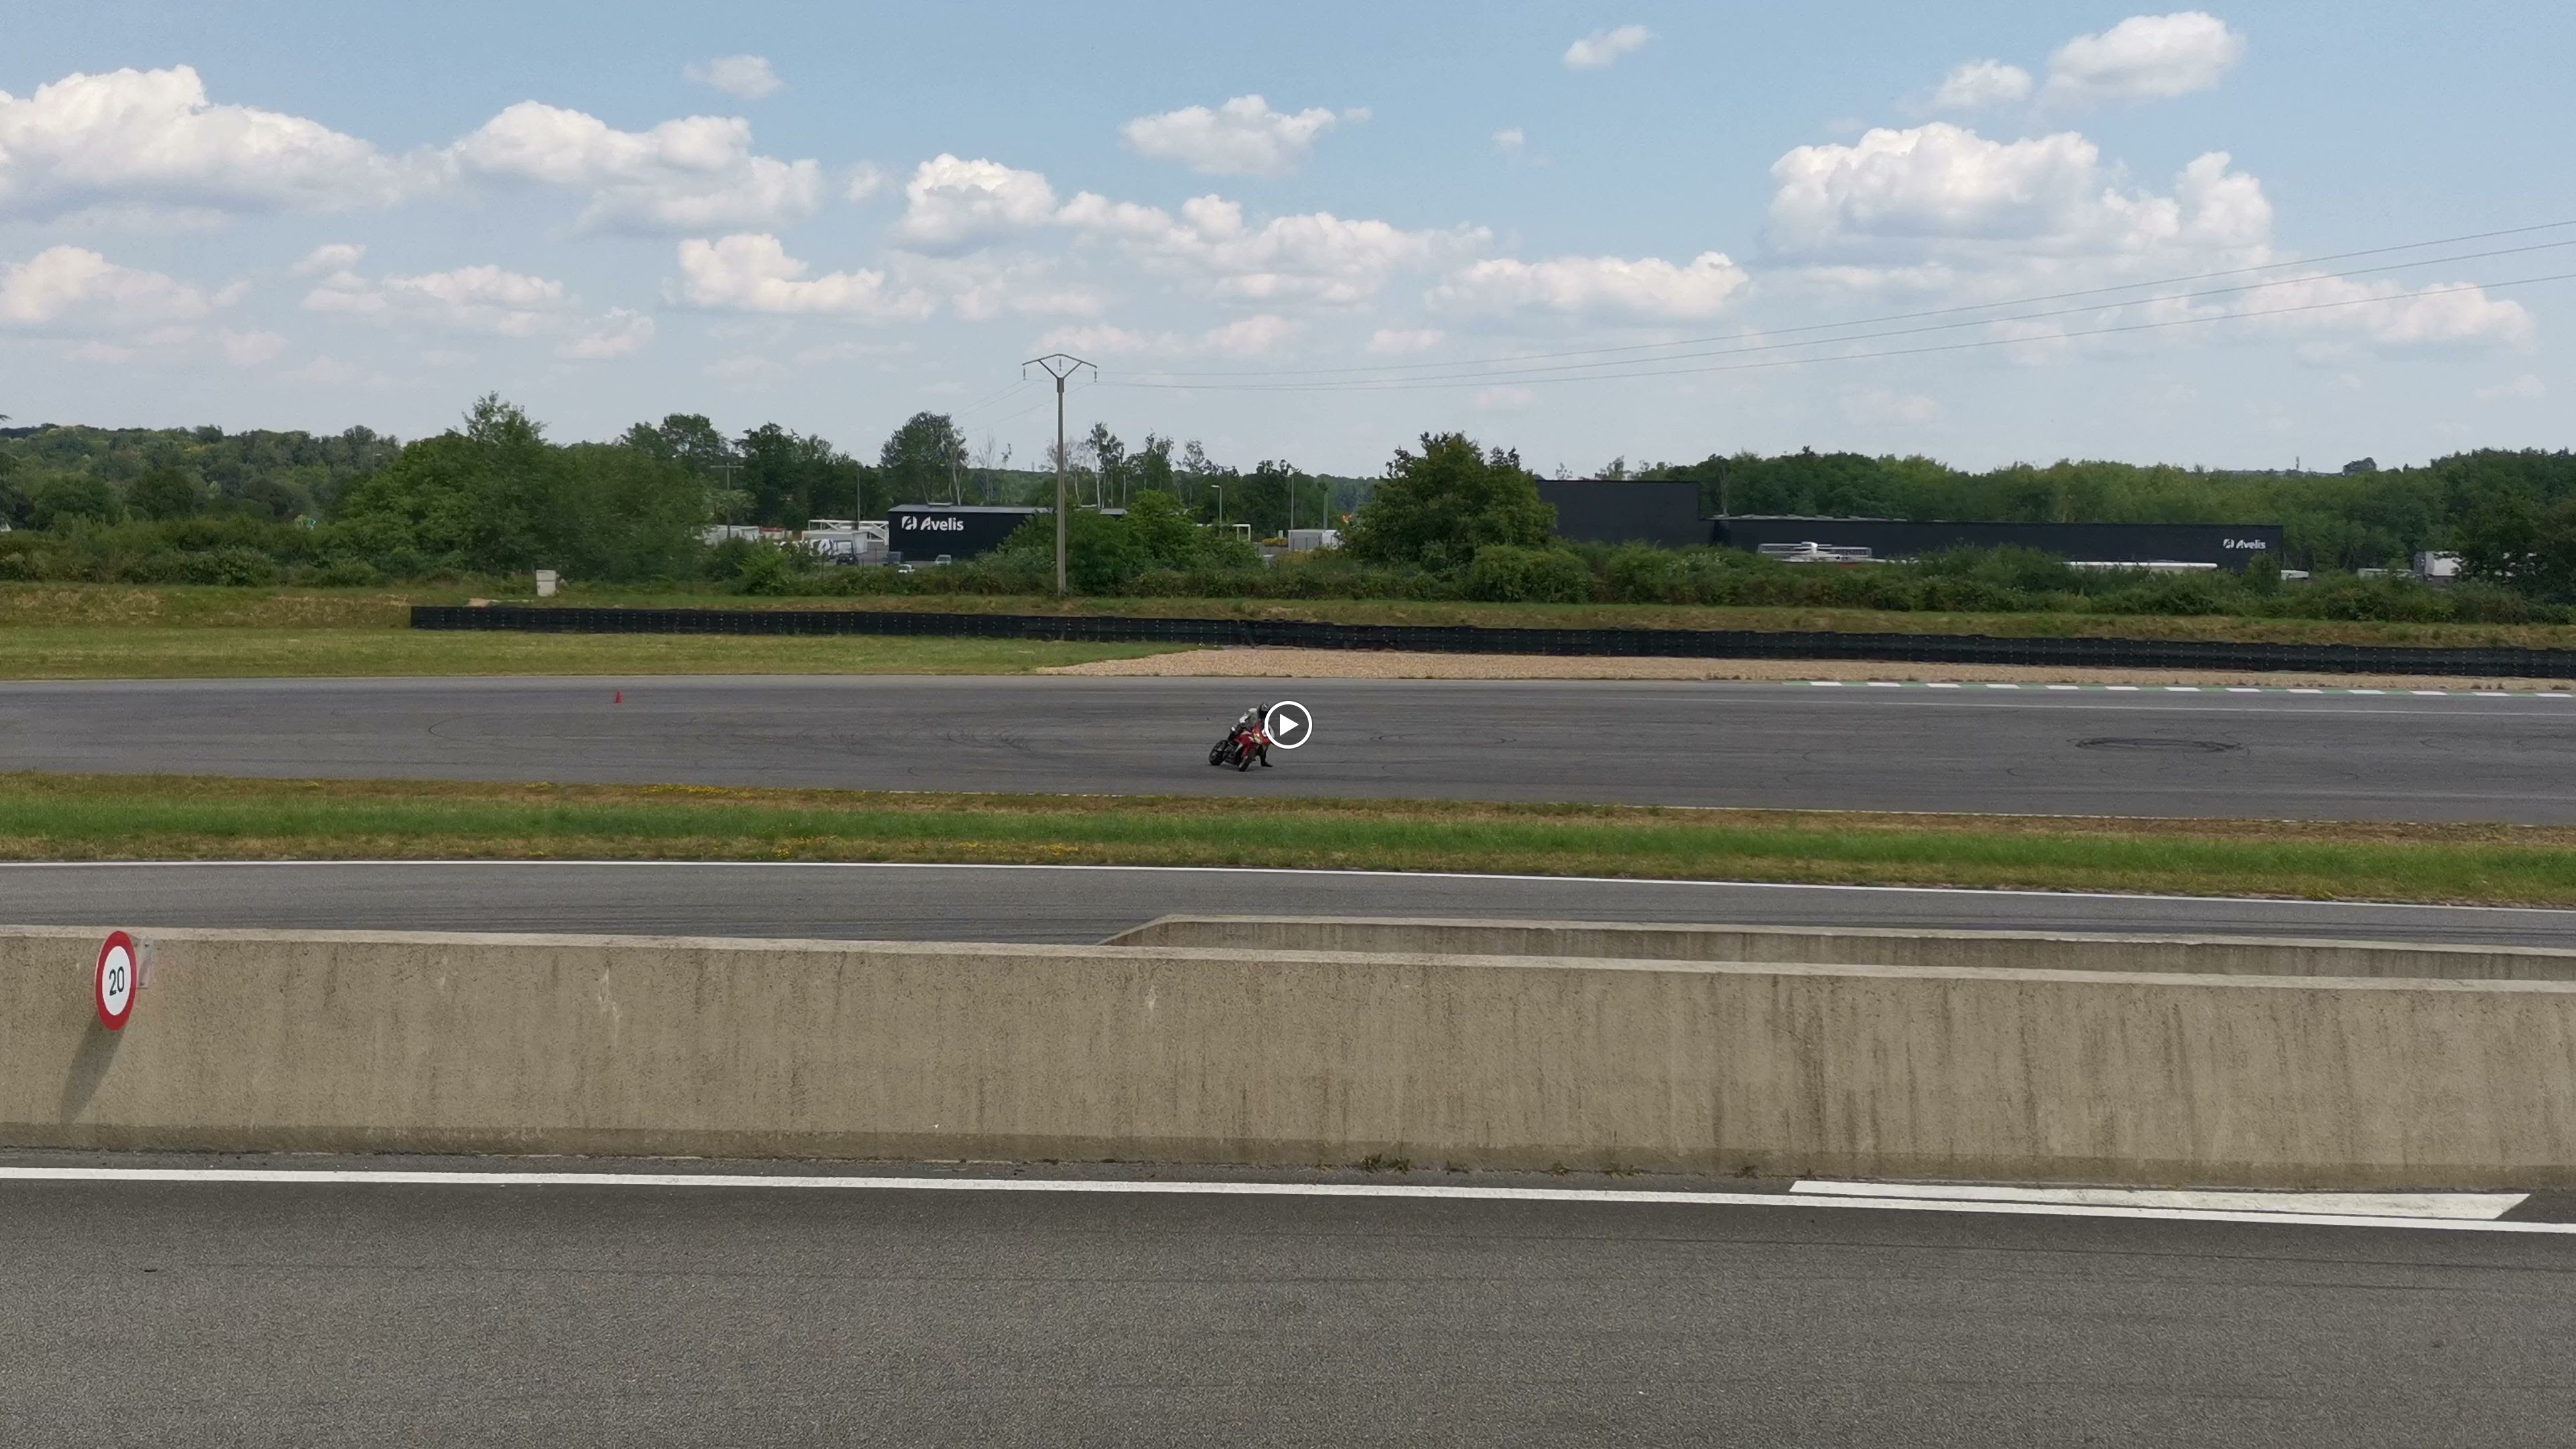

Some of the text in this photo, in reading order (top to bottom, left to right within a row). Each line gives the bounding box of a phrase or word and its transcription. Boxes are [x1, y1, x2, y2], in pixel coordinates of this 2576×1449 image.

[920, 516, 964, 531] Avelis
[2236, 539, 2266, 549] Avelis
[109, 966, 125, 996] 20
